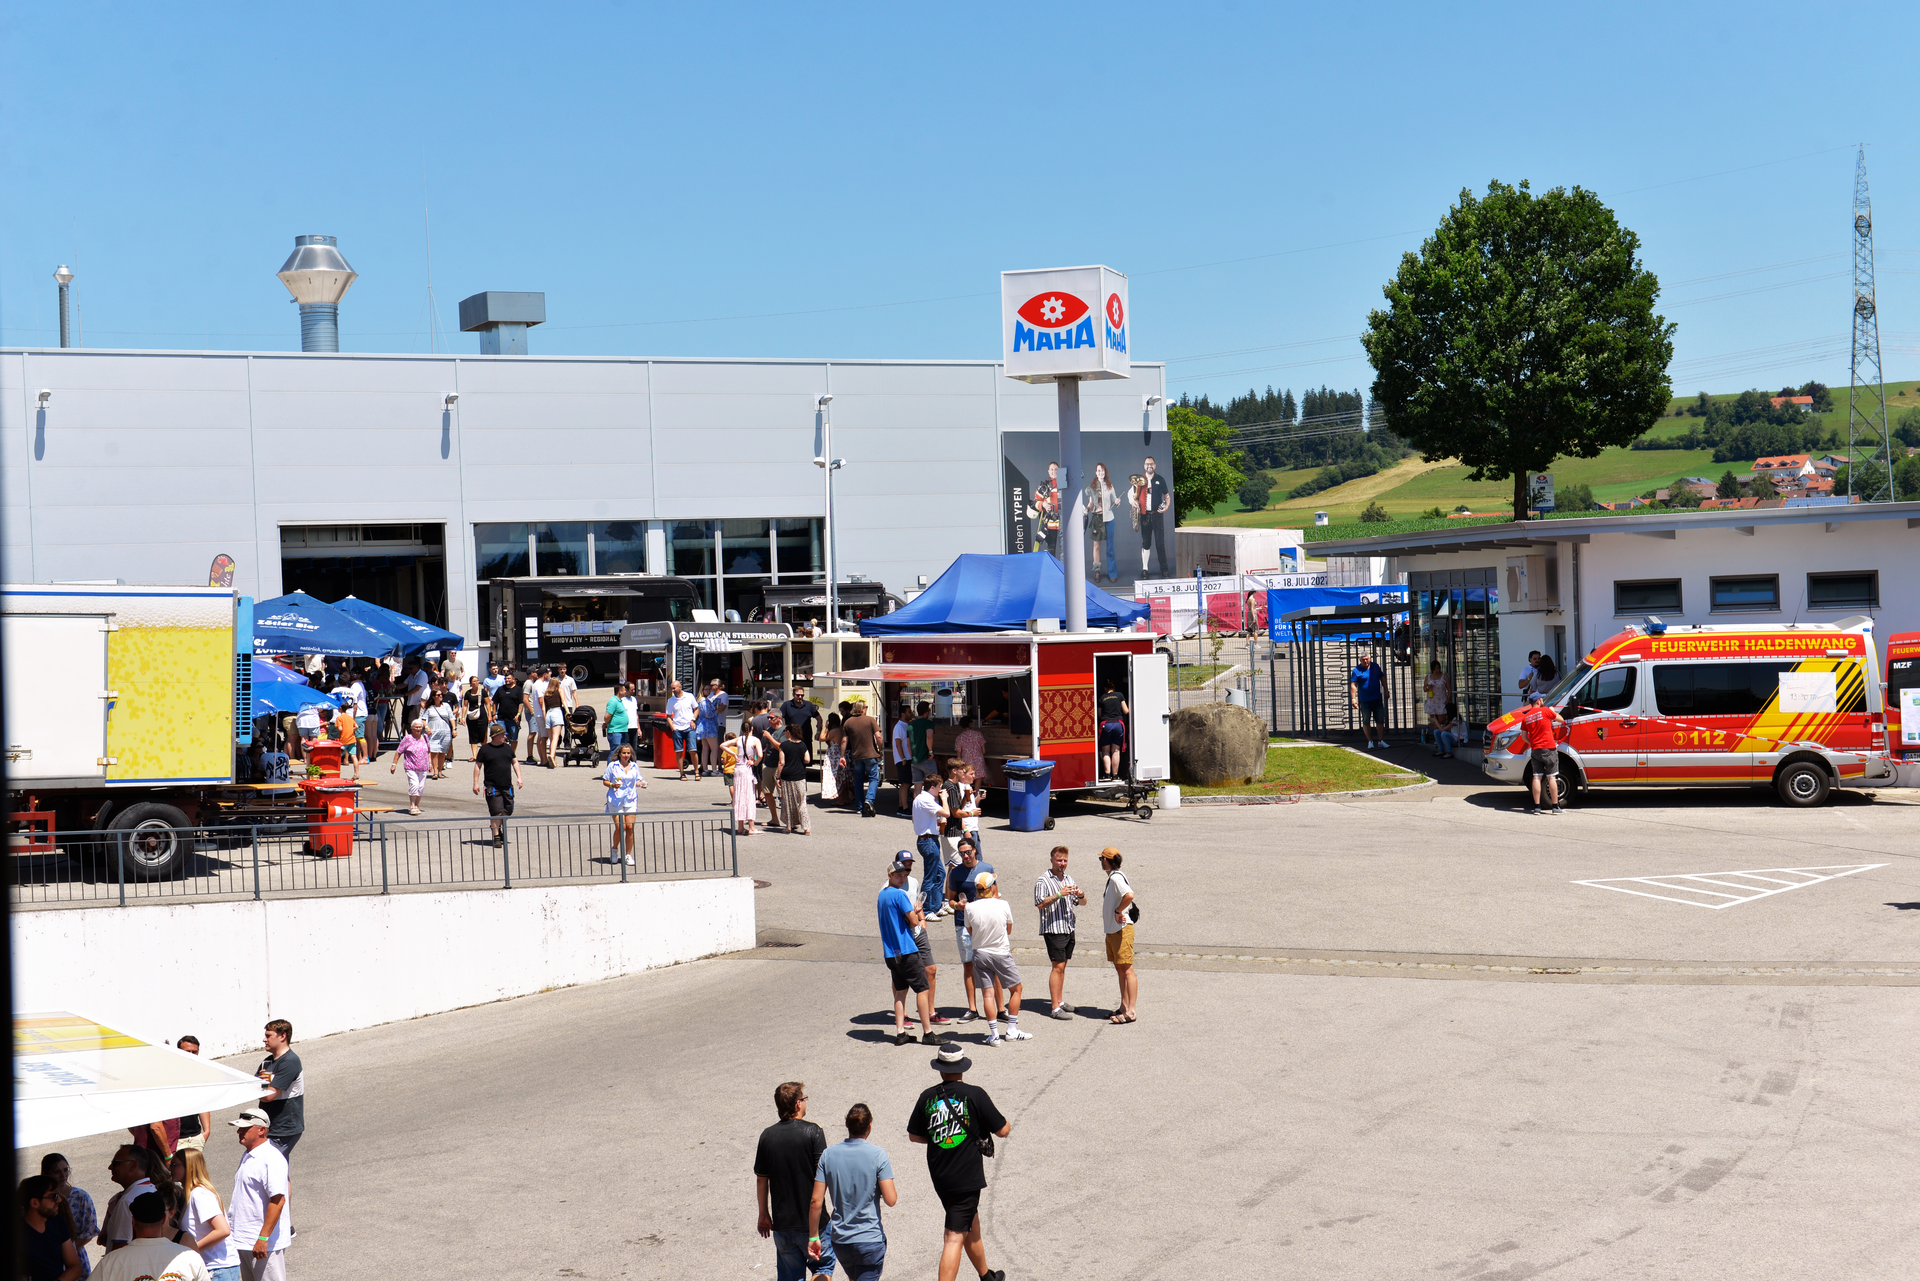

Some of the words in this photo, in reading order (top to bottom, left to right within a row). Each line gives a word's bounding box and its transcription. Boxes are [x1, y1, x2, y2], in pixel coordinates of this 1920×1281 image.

[1013, 315, 1096, 353] MAHA
[1105, 316, 1127, 354] MAHA
[1013, 487, 1023, 522] TYPEN
[1266, 579, 1276, 588] 15.
[1283, 578, 1294, 587] 18.
[1295, 577, 1309, 587] JULI
[1311, 576, 1328, 586] 2027
[1652, 640, 1740, 652] FEUERWEHR
[1744, 638, 1857, 650] HALDENWANG
[684, 646, 692, 692] BAVARICAN
[1688, 730, 1726, 746] 112
[927, 1101, 964, 1130] SANTA
[934, 1120, 961, 1144] CRUZ
